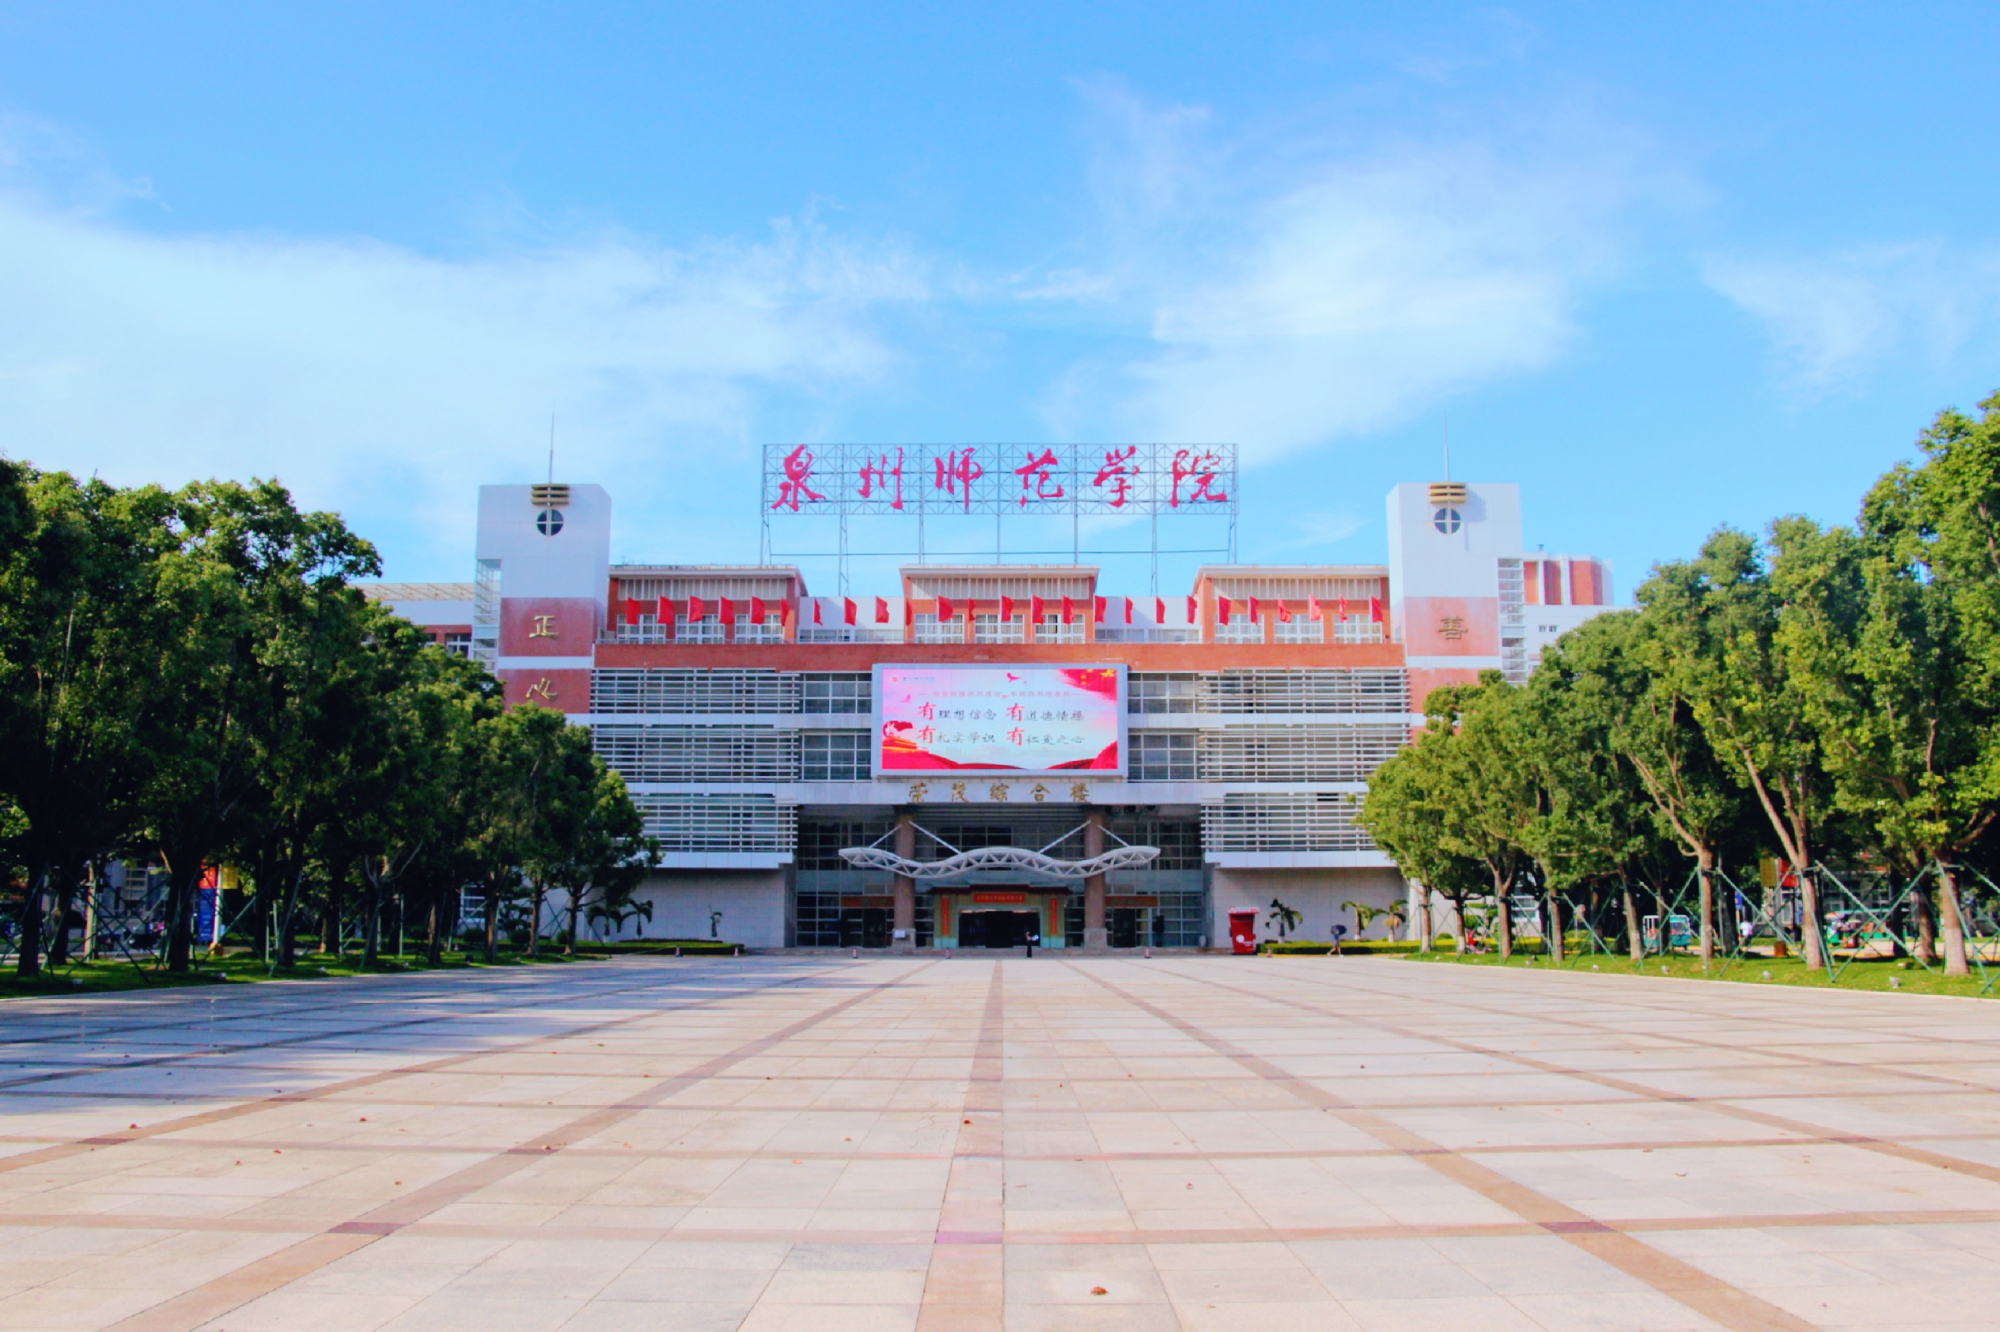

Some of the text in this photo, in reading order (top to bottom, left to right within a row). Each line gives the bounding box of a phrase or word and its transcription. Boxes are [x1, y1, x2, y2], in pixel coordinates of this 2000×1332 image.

[771, 444, 1228, 514] 泉州师范学院
[917, 701, 1084, 722] 有理想信念 有道德情操
[917, 725, 1085, 747] 有扎实学识 有仁爱之心
[908, 781, 1090, 804] 荣茂综合楼
